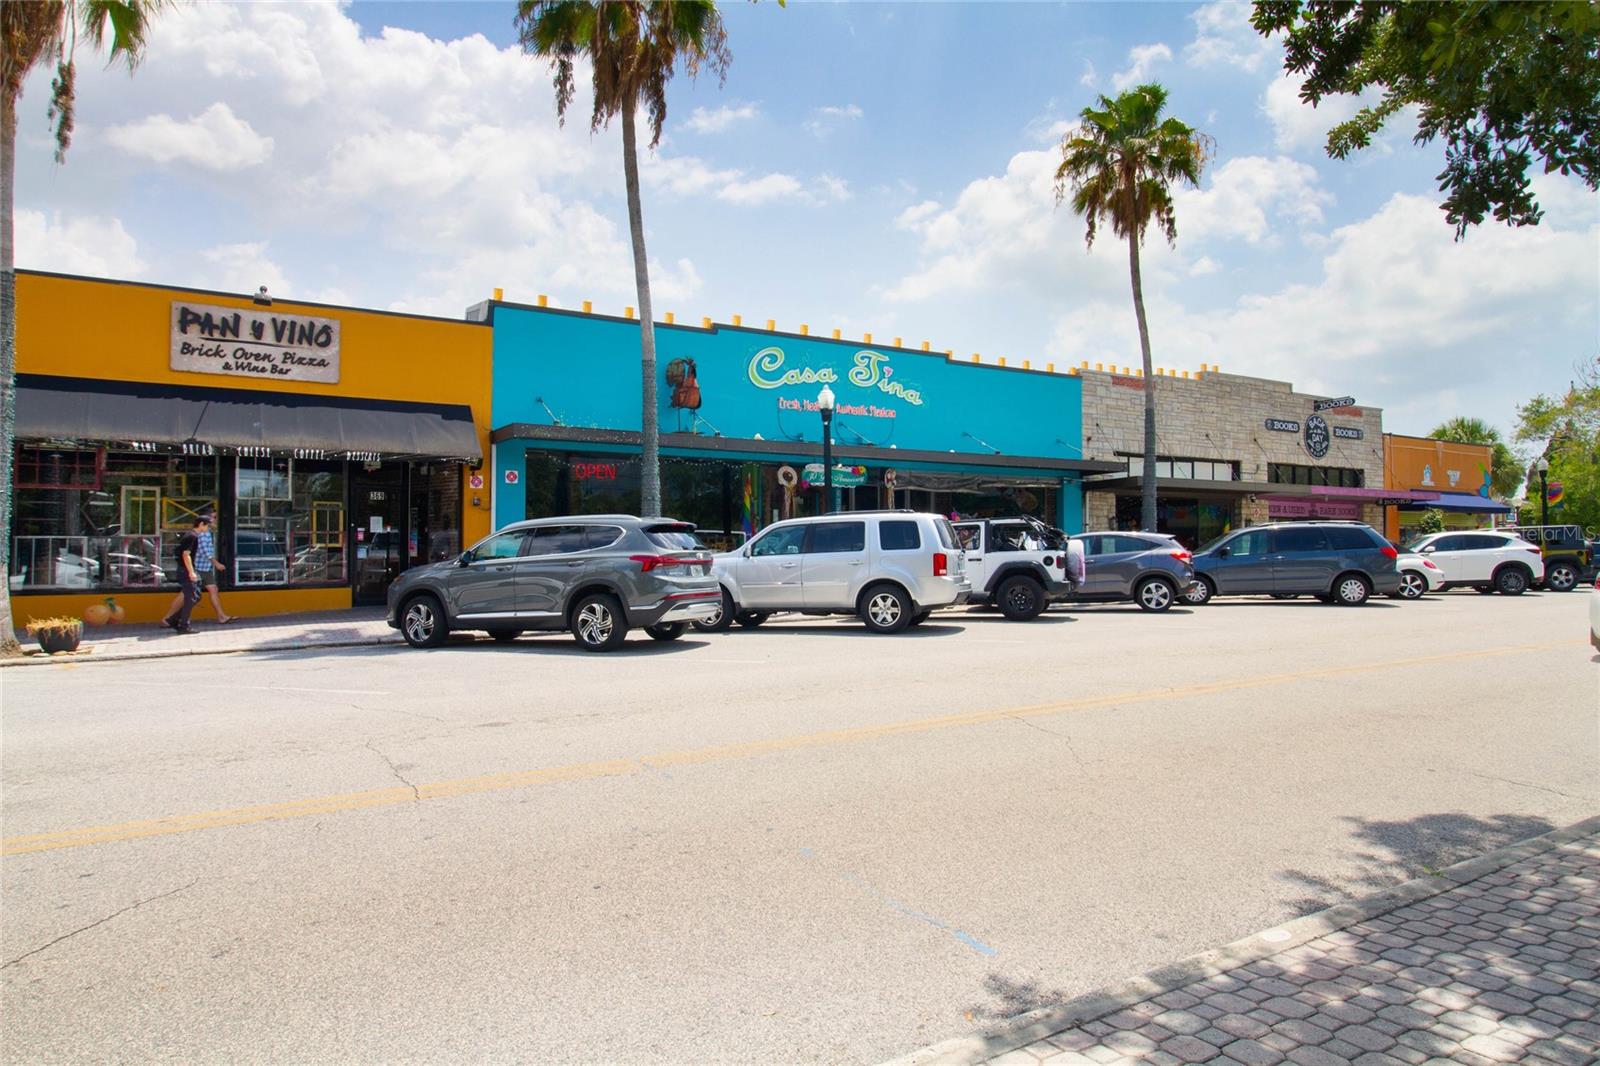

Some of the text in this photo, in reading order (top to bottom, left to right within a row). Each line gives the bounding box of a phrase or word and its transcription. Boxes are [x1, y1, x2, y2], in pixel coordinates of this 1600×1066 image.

[179, 307, 241, 338] PAN
[271, 317, 333, 348] VINO
[180, 341, 330, 367] Brick Oven Pizza
[222, 361, 291, 375] & Wine Bar
[748, 346, 923, 405] Casa Tina
[1319, 398, 1354, 410] BOOKS
[1273, 421, 1299, 431] BOOKS
[1308, 417, 1326, 430] BACK
[1311, 434, 1324, 442] DAY
[1335, 428, 1358, 438] BOOKS
[575, 463, 617, 481] OPEN
